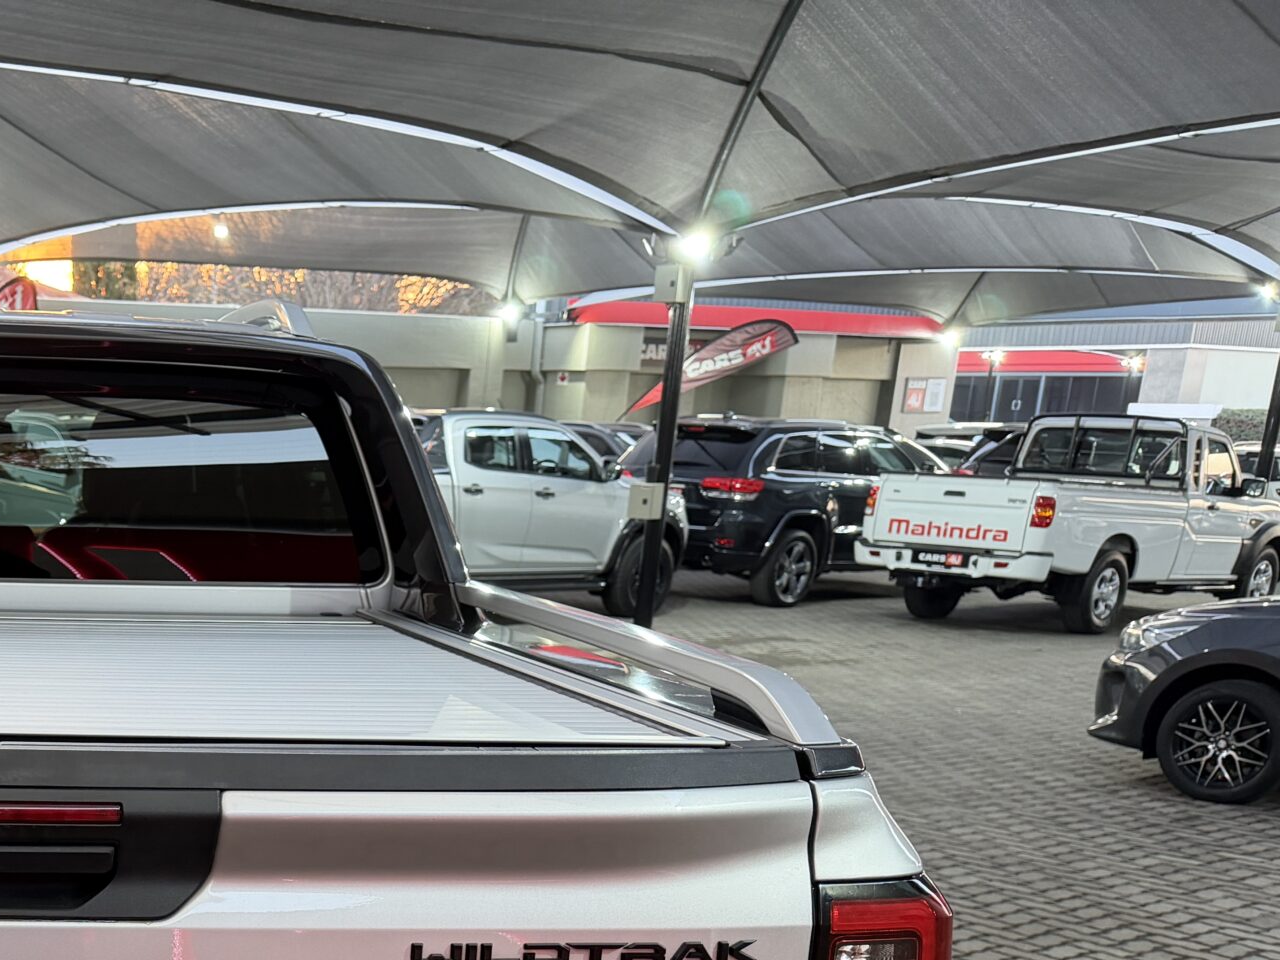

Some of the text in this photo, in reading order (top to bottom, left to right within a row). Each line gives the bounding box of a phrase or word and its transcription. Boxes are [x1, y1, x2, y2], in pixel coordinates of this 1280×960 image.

[687, 335, 772, 378] CARS 4U
[888, 518, 1008, 542] Mahindra
[918, 552, 946, 563] CARS
